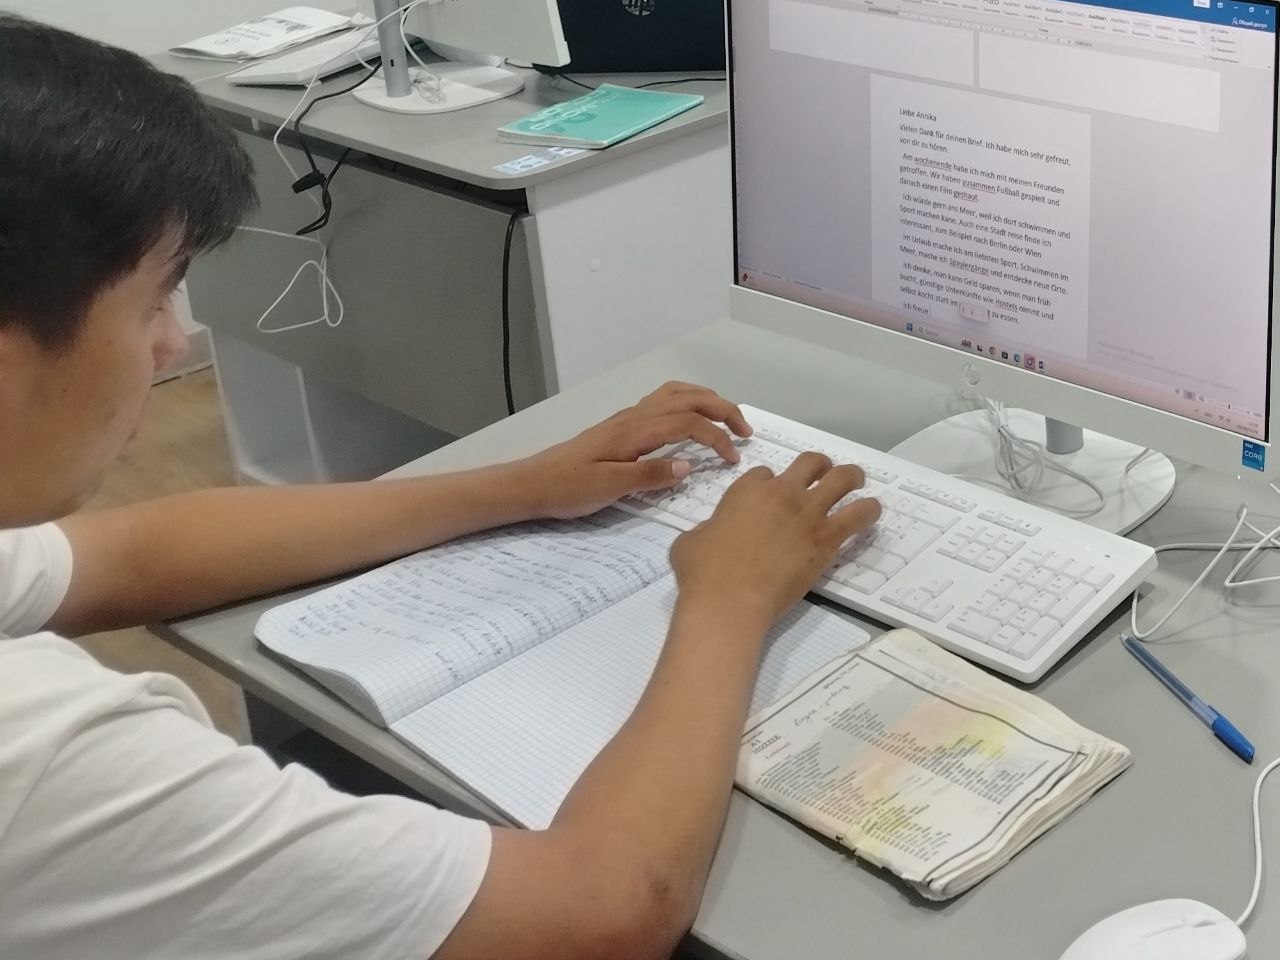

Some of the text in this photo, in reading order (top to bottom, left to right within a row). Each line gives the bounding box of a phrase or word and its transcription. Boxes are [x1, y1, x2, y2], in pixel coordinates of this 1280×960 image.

[900, 108, 936, 122] Liebe Annika
[900, 124, 1070, 167] Vielen Dank für deinen Brief. Ich habe mich sehr gefreut,
[930, 142, 949, 152] hören.
[900, 166, 928, 178] getroffen.
[930, 171, 940, 179] Wir
[942, 174, 960, 184] haben
[962, 180, 996, 192] yusammen
[996, 186, 1020, 198] Fußball
[900, 177, 920, 188] danach
[922, 182, 938, 192] einen
[940, 186, 952, 195] Film
[914, 156, 952, 170] wochenende
[953, 163, 968, 174] habe
[970, 167, 978, 175] ich
[980, 170, 995, 179] mich
[996, 174, 1007, 182] mit
[1008, 176, 1032, 187] meinen
[1034, 181, 1064, 194] Freunden
[900, 204, 916, 214] Sport
[916, 209, 940, 220] machen
[941, 214, 958, 225] kann.
[958, 219, 974, 229] Auch
[976, 224, 988, 232] eine
[990, 226, 1006, 236] Stadt
[1008, 232, 1024, 240] reise
[1024, 234, 1040, 245] finde
[912, 196, 932, 206] würde
[932, 202, 946, 210] gern
[960, 206, 978, 218] Meer,
[979, 212, 992, 220] weil
[1003, 217, 1016, 226] dort
[1018, 221, 1056, 236] schwimmen
[1058, 232, 1070, 240] und
[912, 236, 932, 246] Urlaub
[932, 242, 952, 252] mache
[974, 252, 998, 264] liebsten
[1000, 258, 1018, 270] Sport,
[1020, 263, 1058, 279] Schwimmen
[935, 226, 948, 235] zum
[949, 228, 972, 241] Beispiel
[974, 236, 988, 245] nach
[990, 239, 1008, 250] Berlin
[1008, 244, 1024, 254] oder
[1024, 248, 1042, 258] Wien
[900, 244, 918, 256] Meer,
[918, 250, 938, 261] mache
[990, 270, 1002, 278] und
[1004, 272, 1032, 286] entdecke
[1034, 281, 1050, 290] neue
[900, 286, 916, 296] selbst
[918, 289, 934, 300] kocht
[936, 296, 948, 304] statt
[900, 273, 918, 284] bucht,
[920, 279, 944, 292] günstige
[946, 284, 982, 300] Unterkünfte
[982, 296, 994, 304] wie
[994, 300, 1018, 311] Hostels
[1019, 305, 1040, 316] nimmt
[1042, 312, 1054, 320] und
[912, 264, 932, 276] denke,
[934, 270, 946, 280] man
[948, 274, 962, 283] kann
[964, 278, 978, 288] Geld
[980, 283, 1001, 295] sparen,
[1004, 289, 1020, 299] wenn
[1022, 294, 1036, 303] man
[1038, 297, 1050, 307] früh
[912, 304, 929, 314] freue
[1000, 314, 1020, 324] essen.
[1244, 450, 1263, 462] CORE
